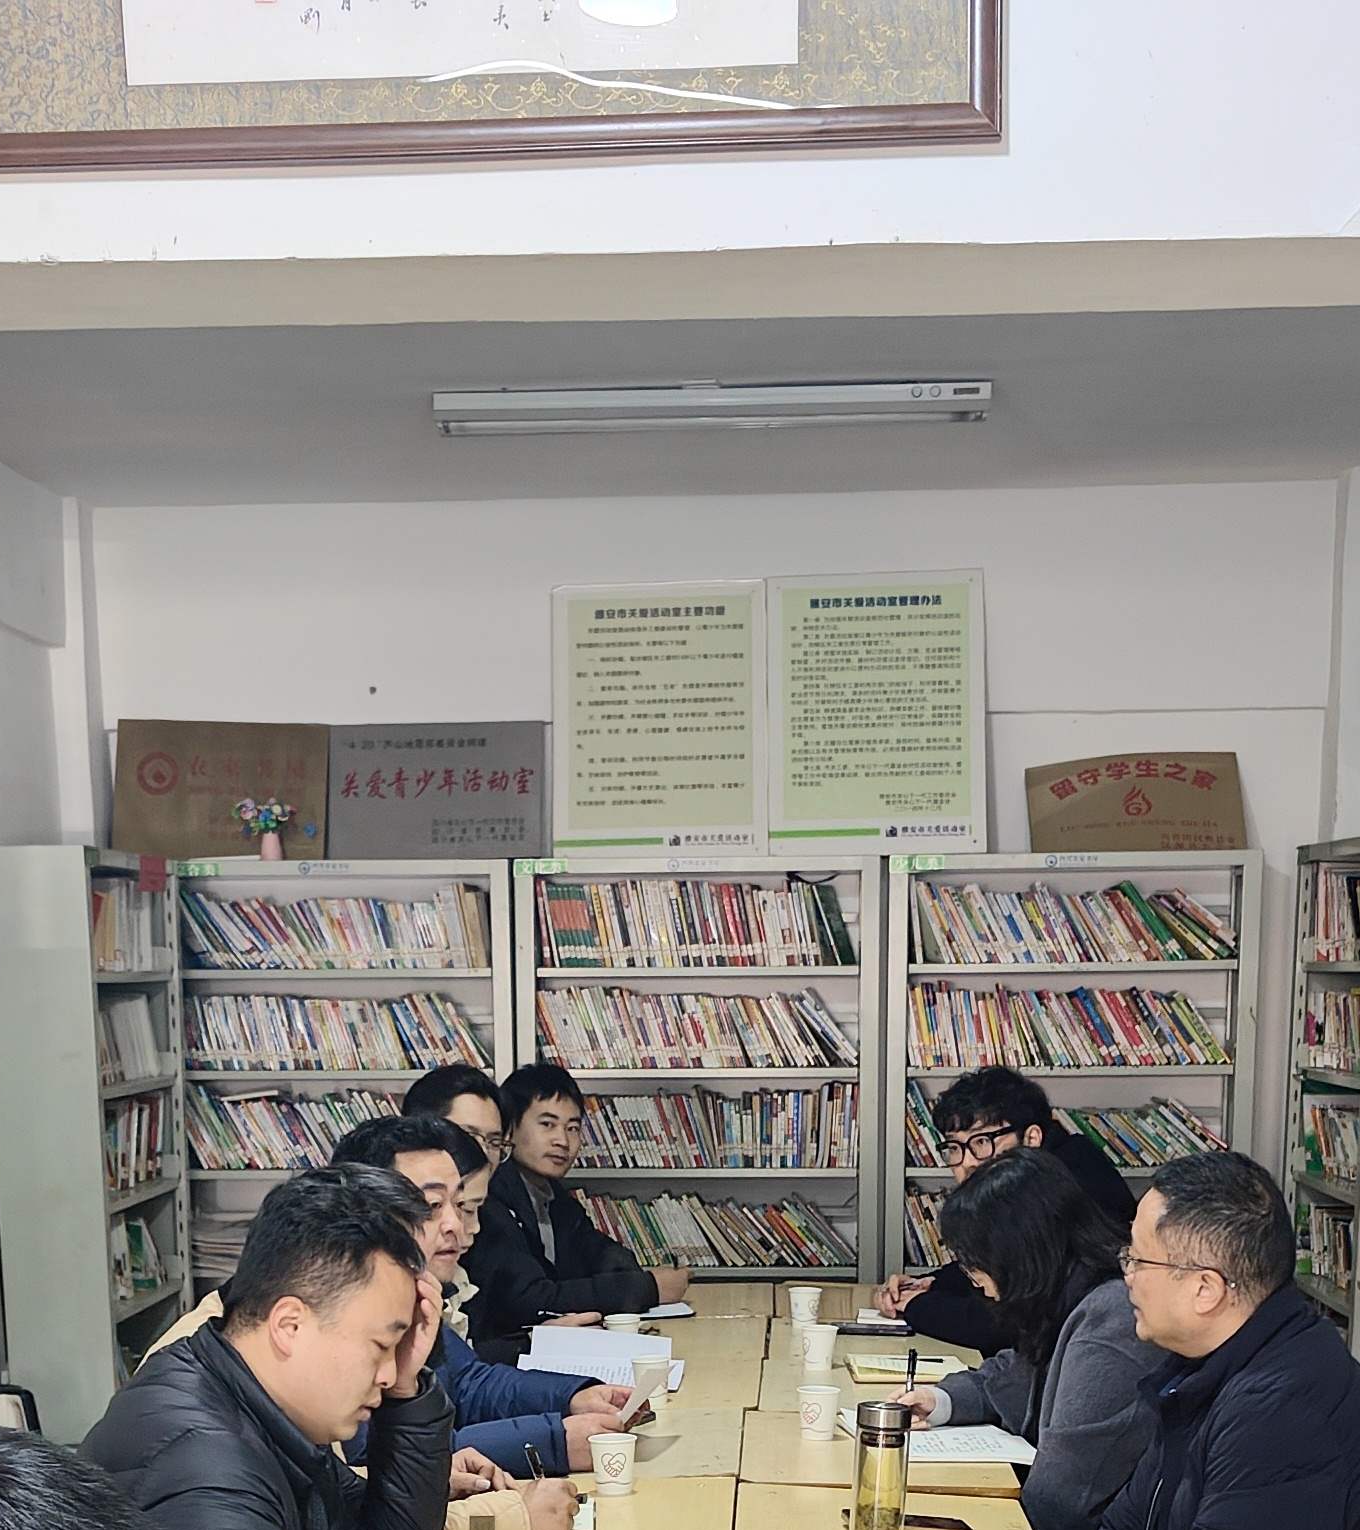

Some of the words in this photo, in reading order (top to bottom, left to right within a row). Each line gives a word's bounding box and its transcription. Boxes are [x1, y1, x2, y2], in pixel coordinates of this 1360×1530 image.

[809, 594, 942, 609] 雅安市关爱活动室管理办法
[341, 766, 535, 799] 关爱青少年活动室
[1049, 759, 1218, 801] 留守学生之家
